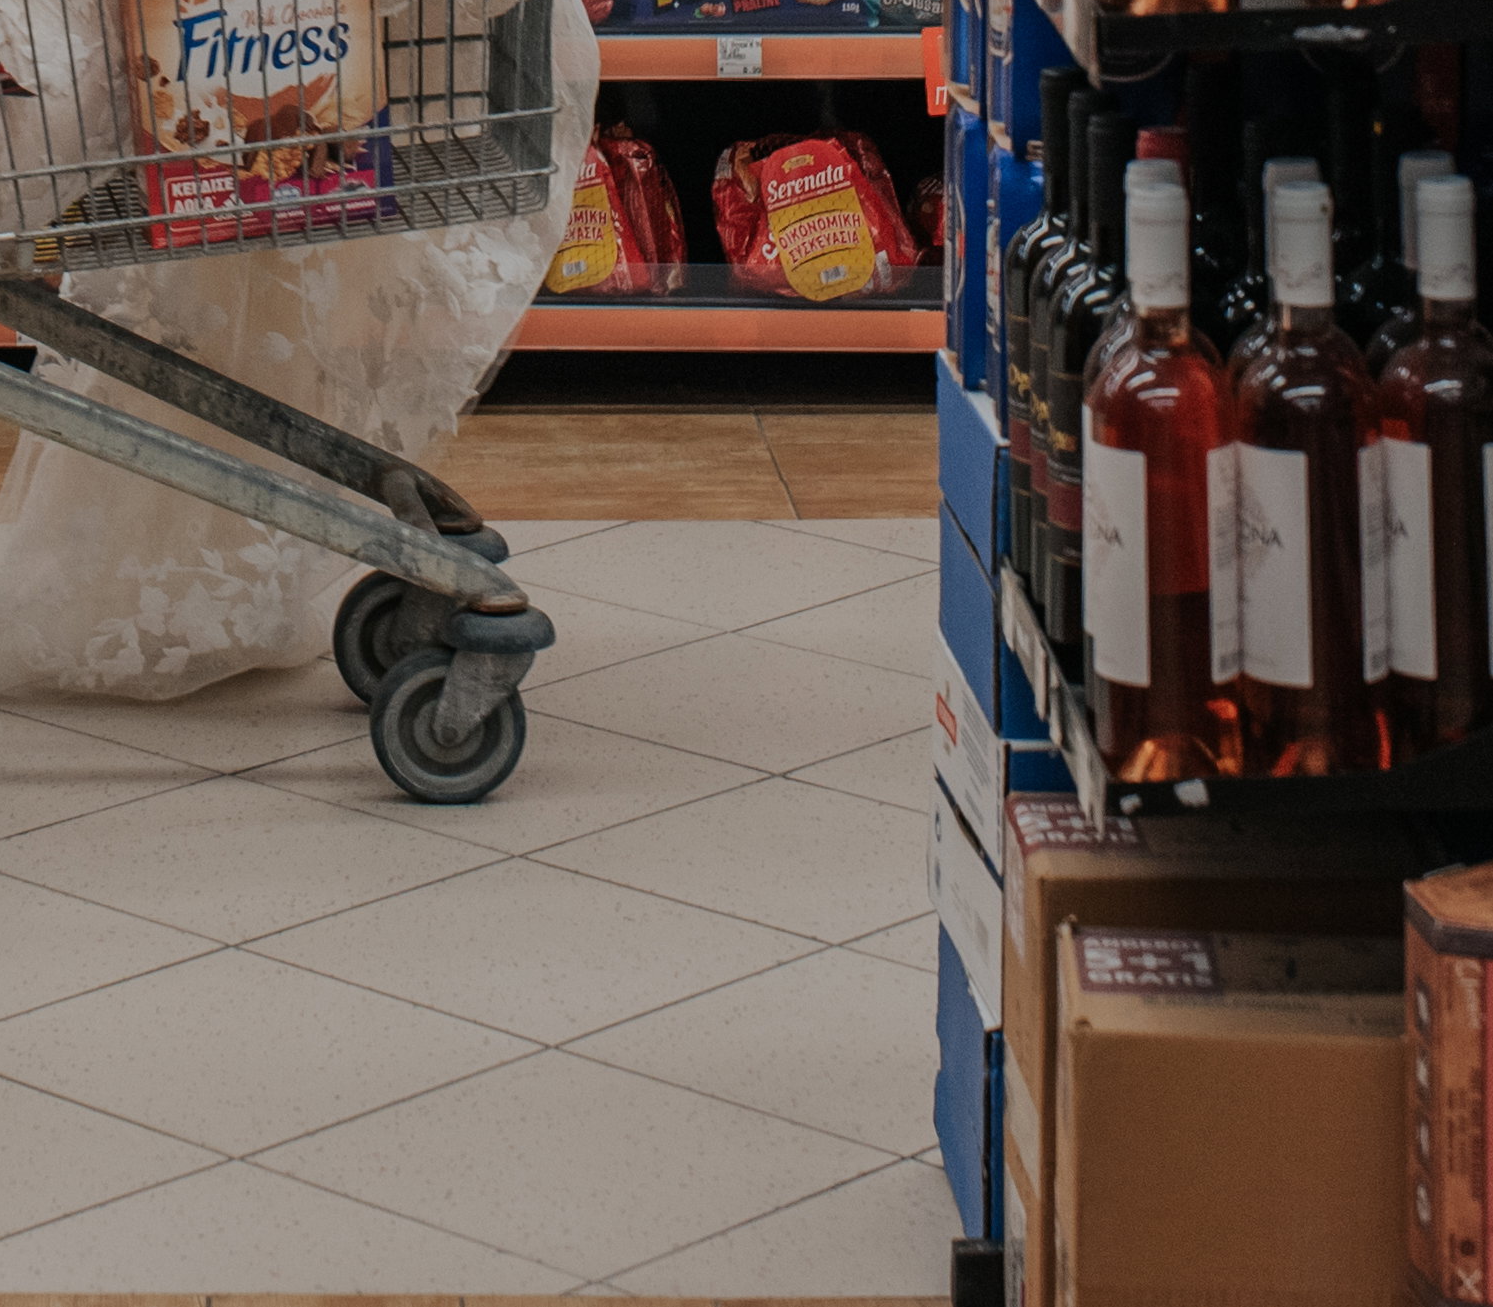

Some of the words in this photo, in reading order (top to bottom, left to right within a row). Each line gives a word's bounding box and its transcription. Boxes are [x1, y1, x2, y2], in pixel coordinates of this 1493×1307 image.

[172, 8, 351, 83] Fitness
[767, 164, 845, 204] Serenata
[778, 213, 862, 250] ΟΙΚΟΝΟΜΙΚΗ
[788, 230, 860, 264] ΣΥΣΚΕΥΑΣΙΑ
[1082, 949, 1210, 972] 5+1
[1087, 971, 1211, 986] GRATIS
